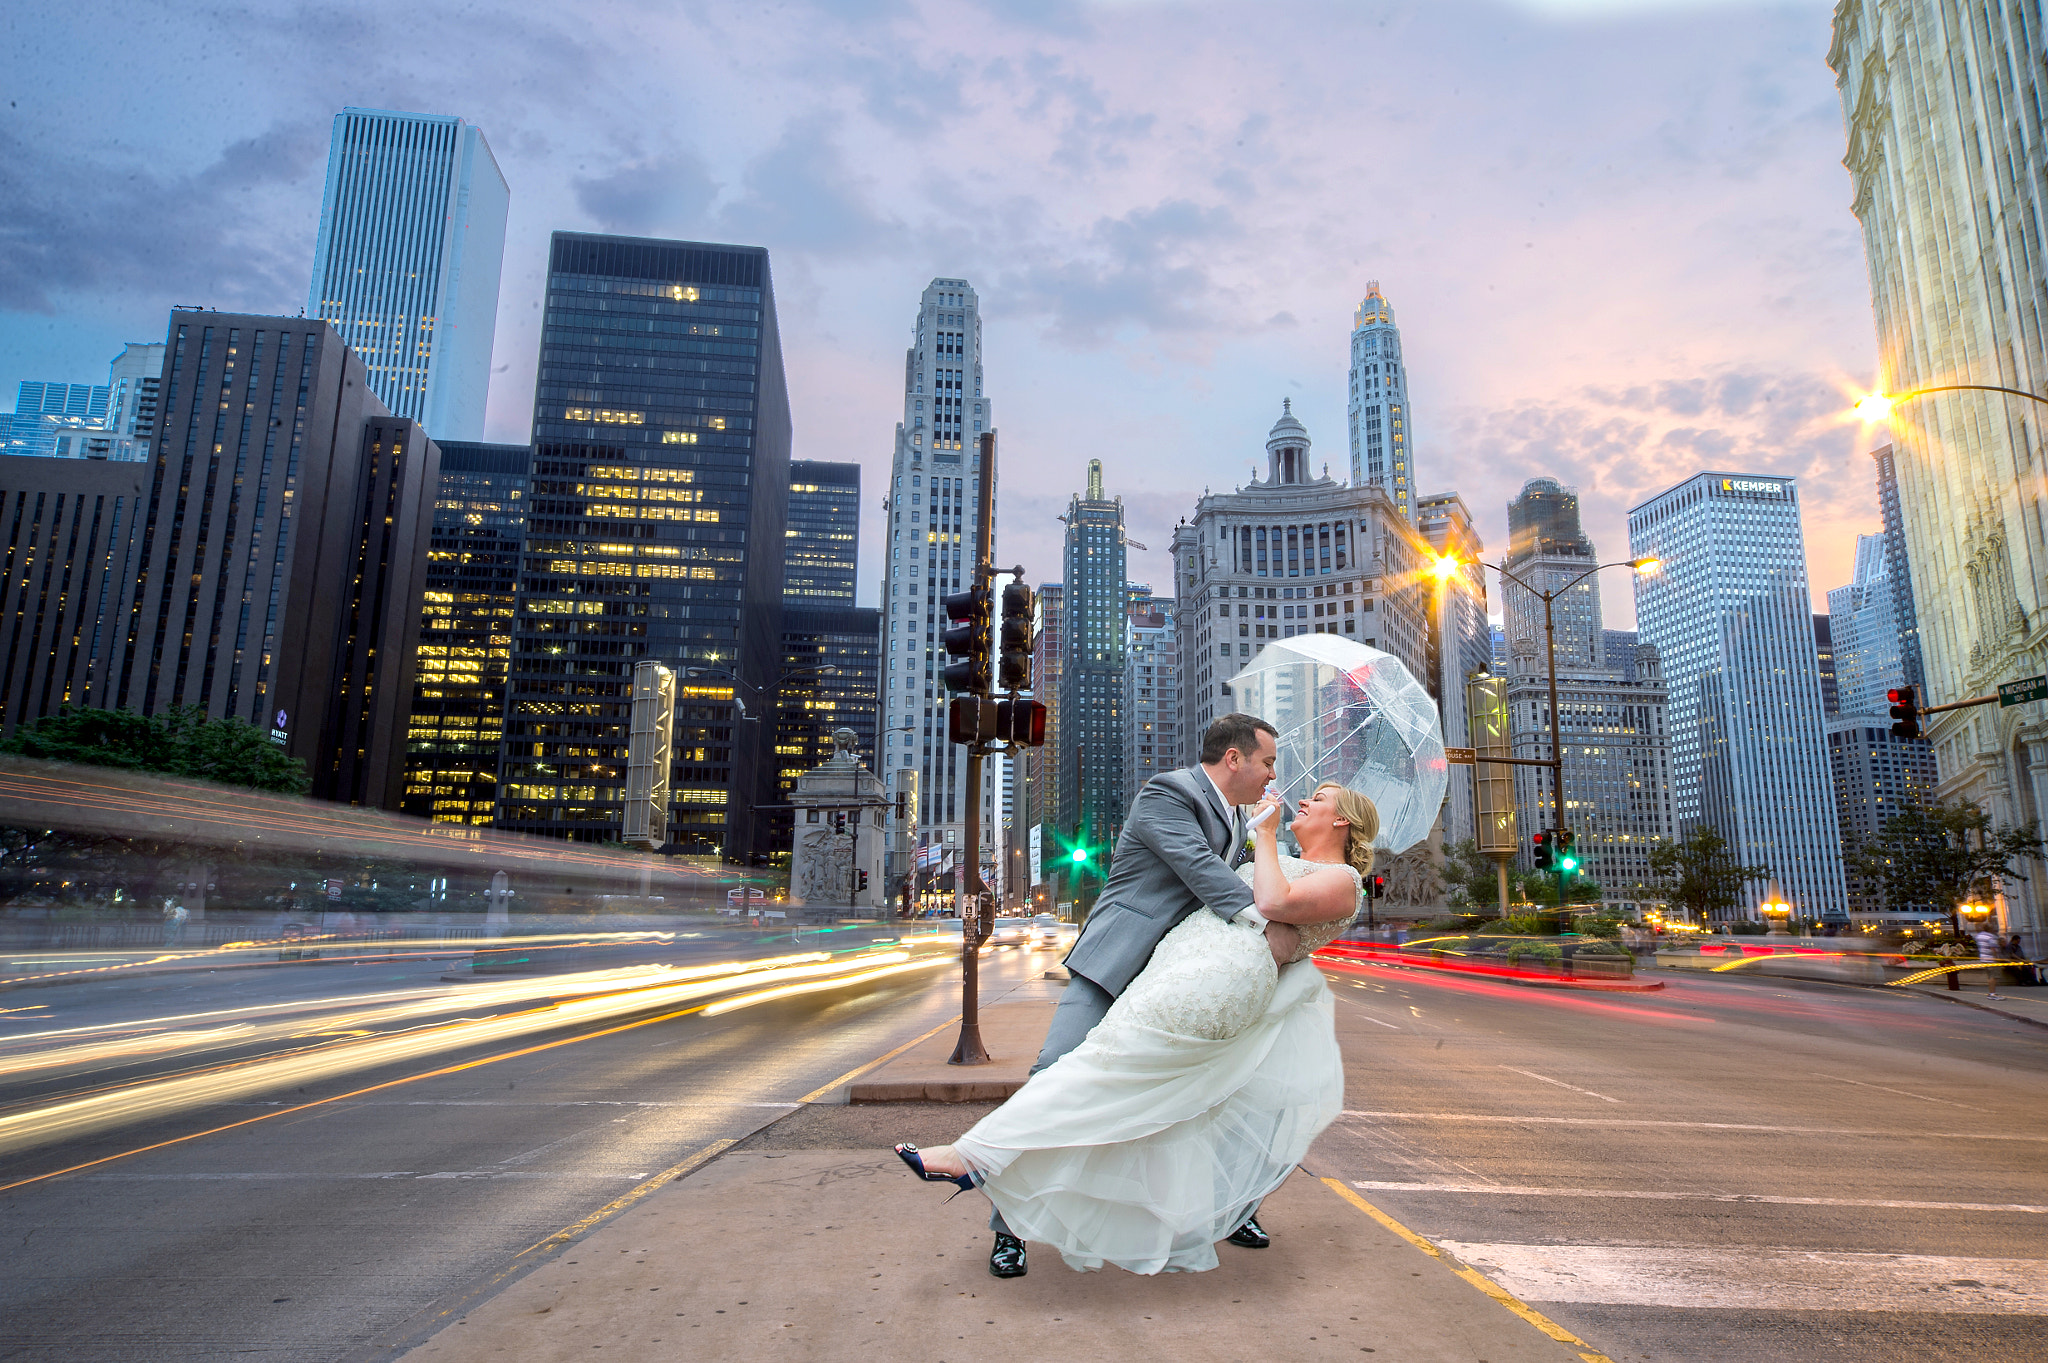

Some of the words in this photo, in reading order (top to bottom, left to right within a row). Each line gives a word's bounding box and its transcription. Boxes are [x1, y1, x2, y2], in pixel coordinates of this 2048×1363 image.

[1733, 480, 1781, 493] KEMPER
[2005, 680, 2037, 695] MICHIGAN
[2029, 691, 2034, 699] E
[271, 728, 288, 740] HYATT
